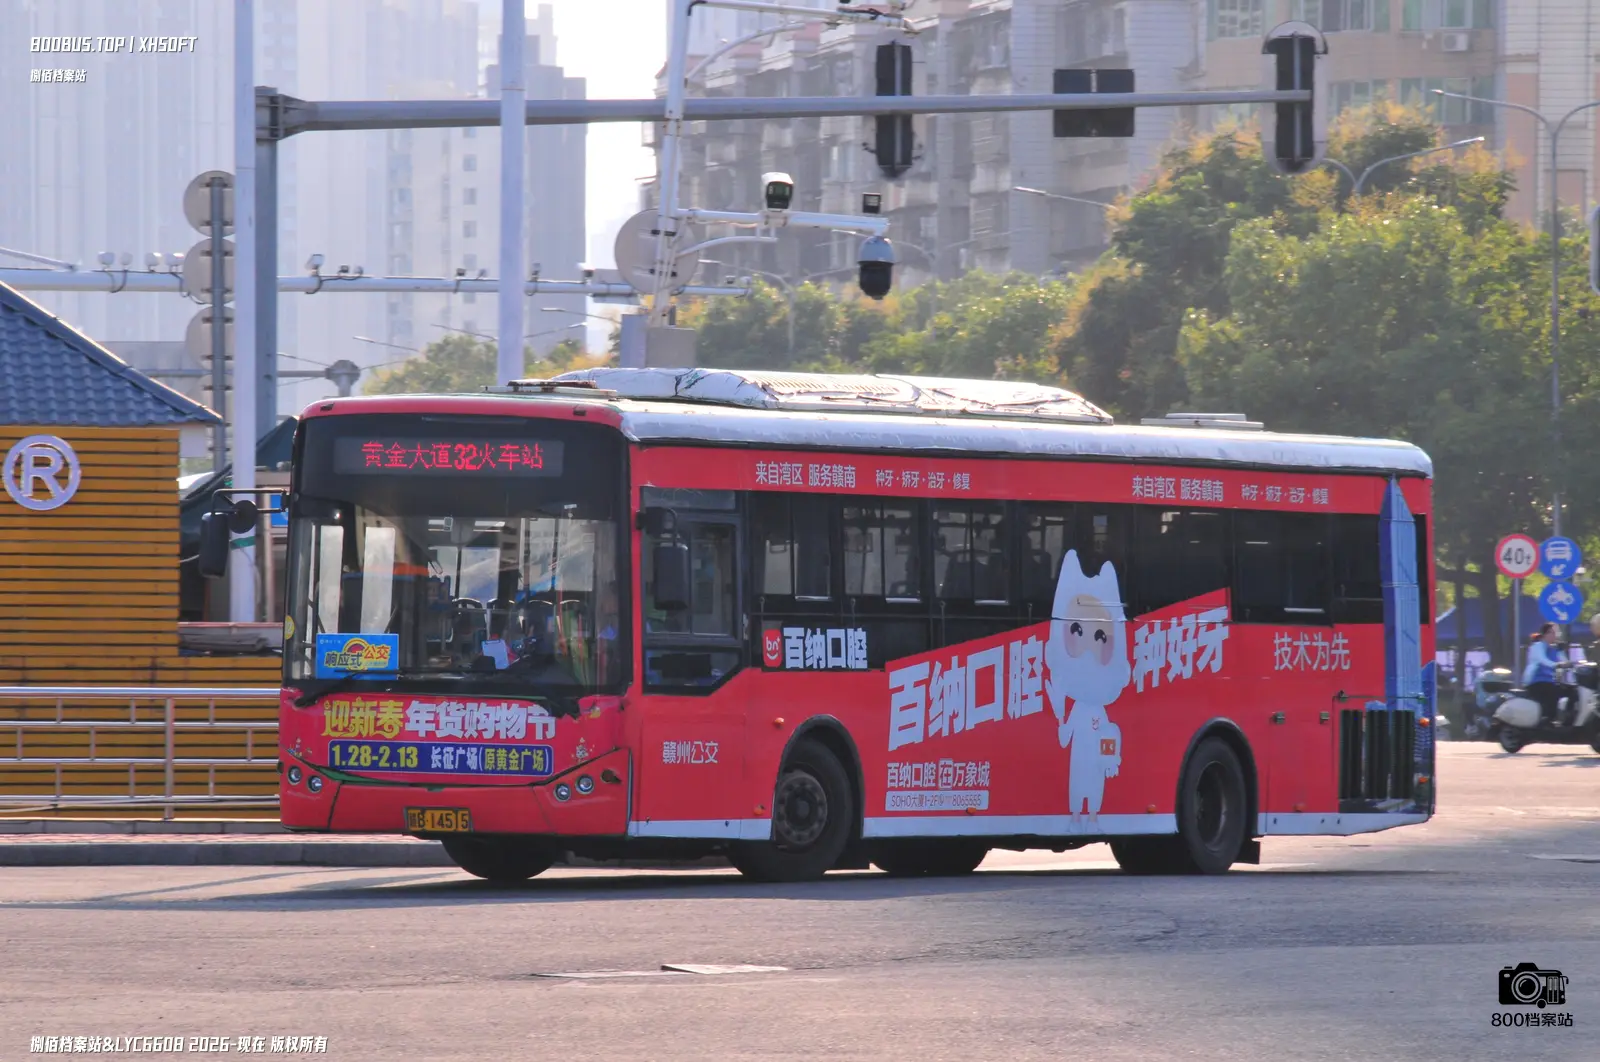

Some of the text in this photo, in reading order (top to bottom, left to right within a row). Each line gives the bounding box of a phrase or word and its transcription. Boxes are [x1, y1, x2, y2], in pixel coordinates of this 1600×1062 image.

[755, 461, 804, 486] 来自湾区
[808, 463, 857, 488] 服务赣南
[1132, 475, 1176, 499] 来自湾区
[1180, 478, 1225, 502] 服务赣南
[1502, 547, 1531, 565] 40t
[783, 627, 868, 669] 百纳口腔
[1273, 631, 1351, 672] 技术为先
[888, 606, 1231, 752] 百纳口腔 种好牙
[321, 697, 556, 740] 迎新春 年货购物节
[331, 744, 419, 769] 1.28-2.13
[662, 740, 718, 764] 赣州公交
